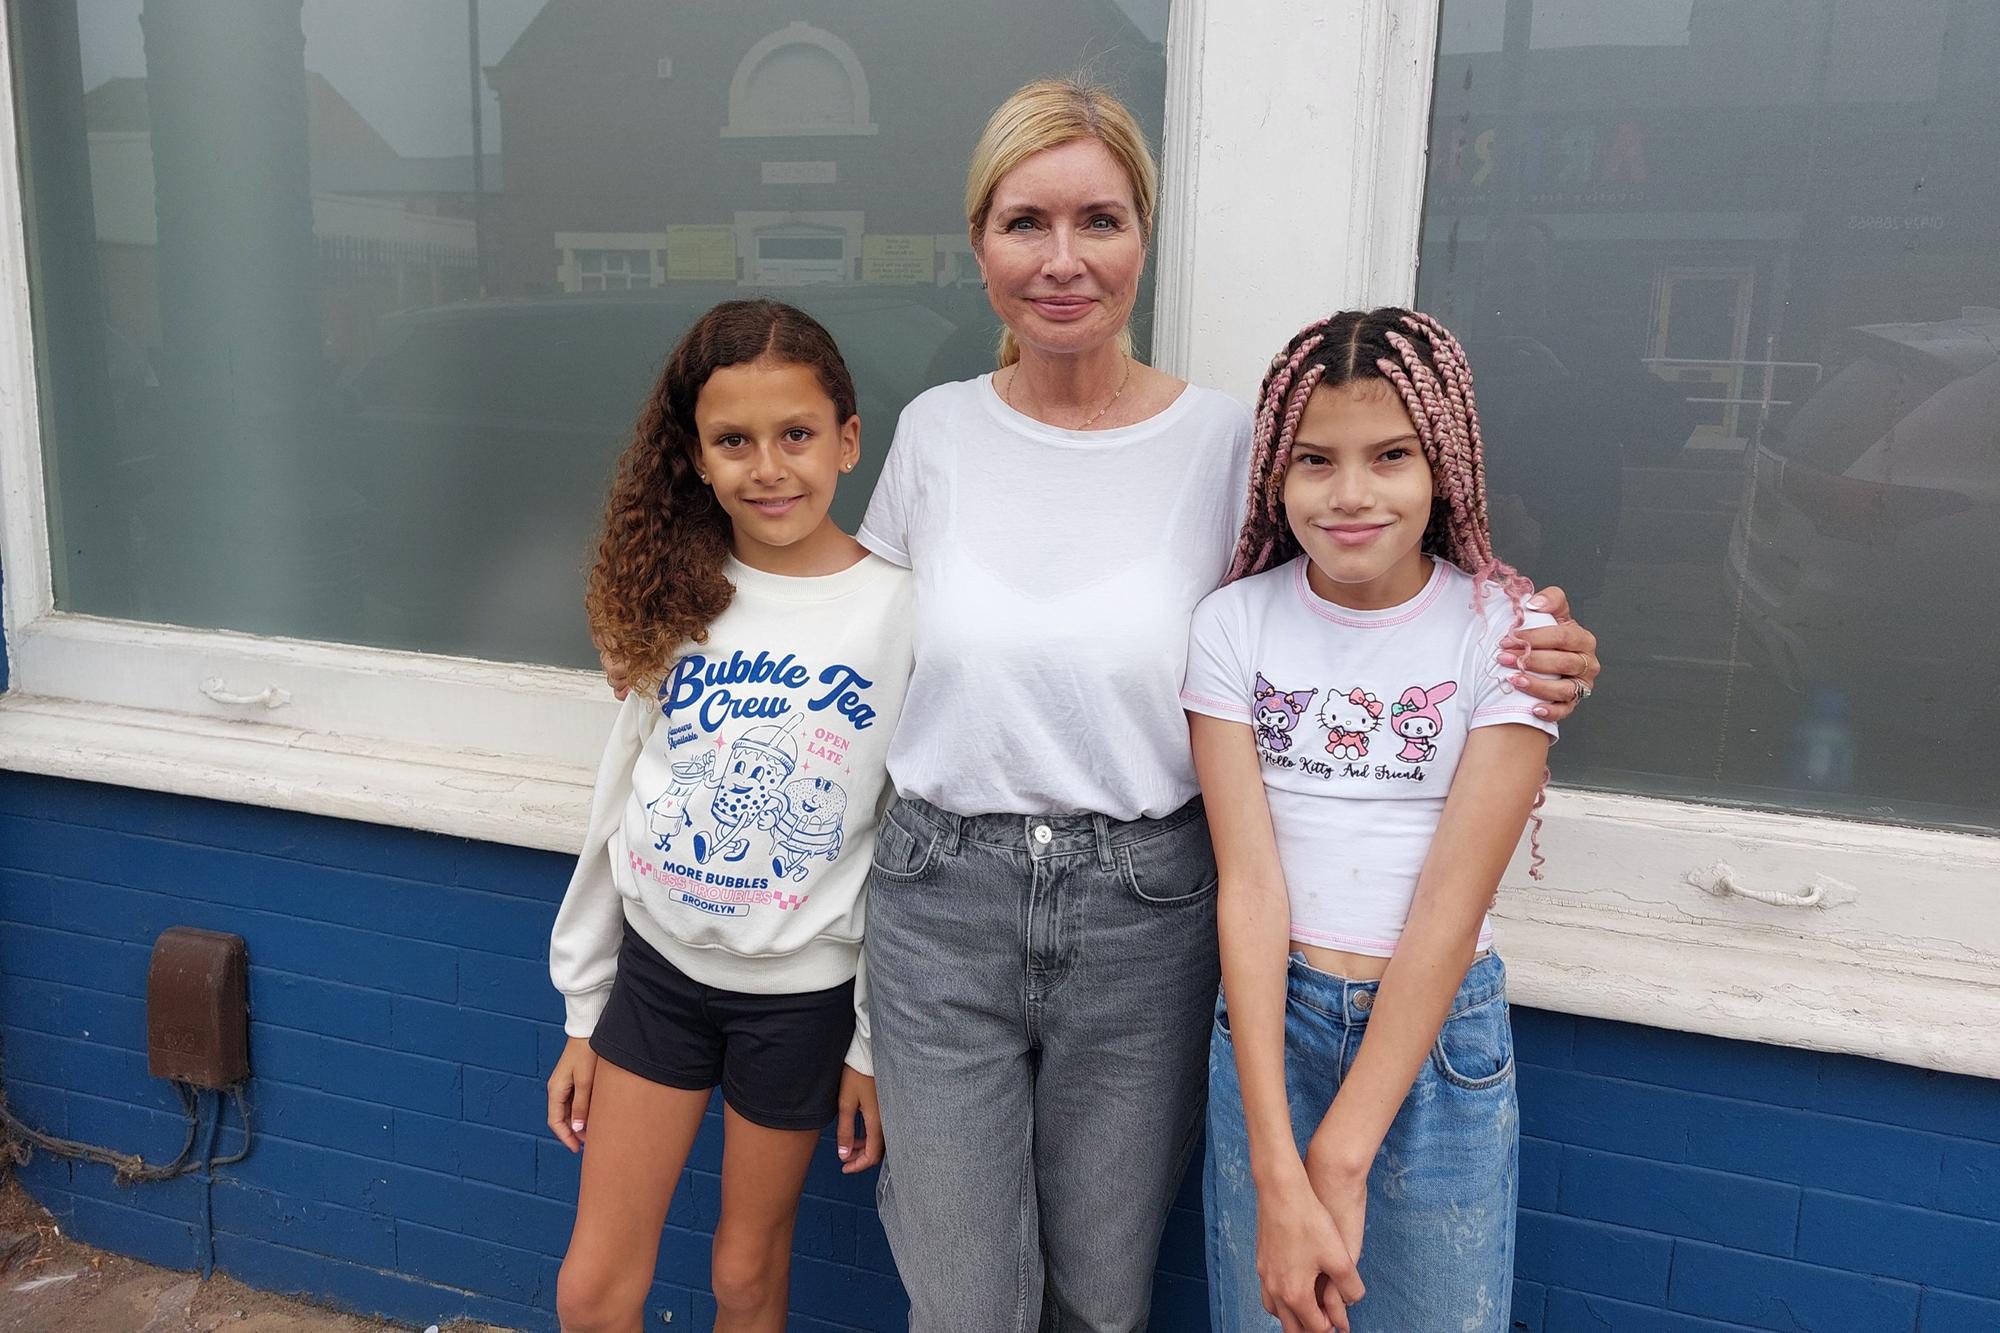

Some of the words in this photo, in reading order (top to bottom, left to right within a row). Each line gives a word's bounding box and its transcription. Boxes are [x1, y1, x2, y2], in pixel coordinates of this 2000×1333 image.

[658, 650, 810, 719] Bubble
[808, 664, 877, 730] Tea
[699, 689, 791, 733] Crew
[807, 741, 844, 766] LATE
[815, 728, 850, 751] OPEN
[1262, 750, 1296, 768] Hello
[1300, 756, 1334, 778] Kitty
[1339, 763, 1370, 778] And
[1374, 764, 1426, 781] Friends
[652, 868, 688, 890] LESS
[689, 880, 773, 905] TROUBLES
[663, 860, 703, 882] MORE
[705, 872, 769, 889] BUBBLES
[682, 893, 736, 914] BROOKLYN
